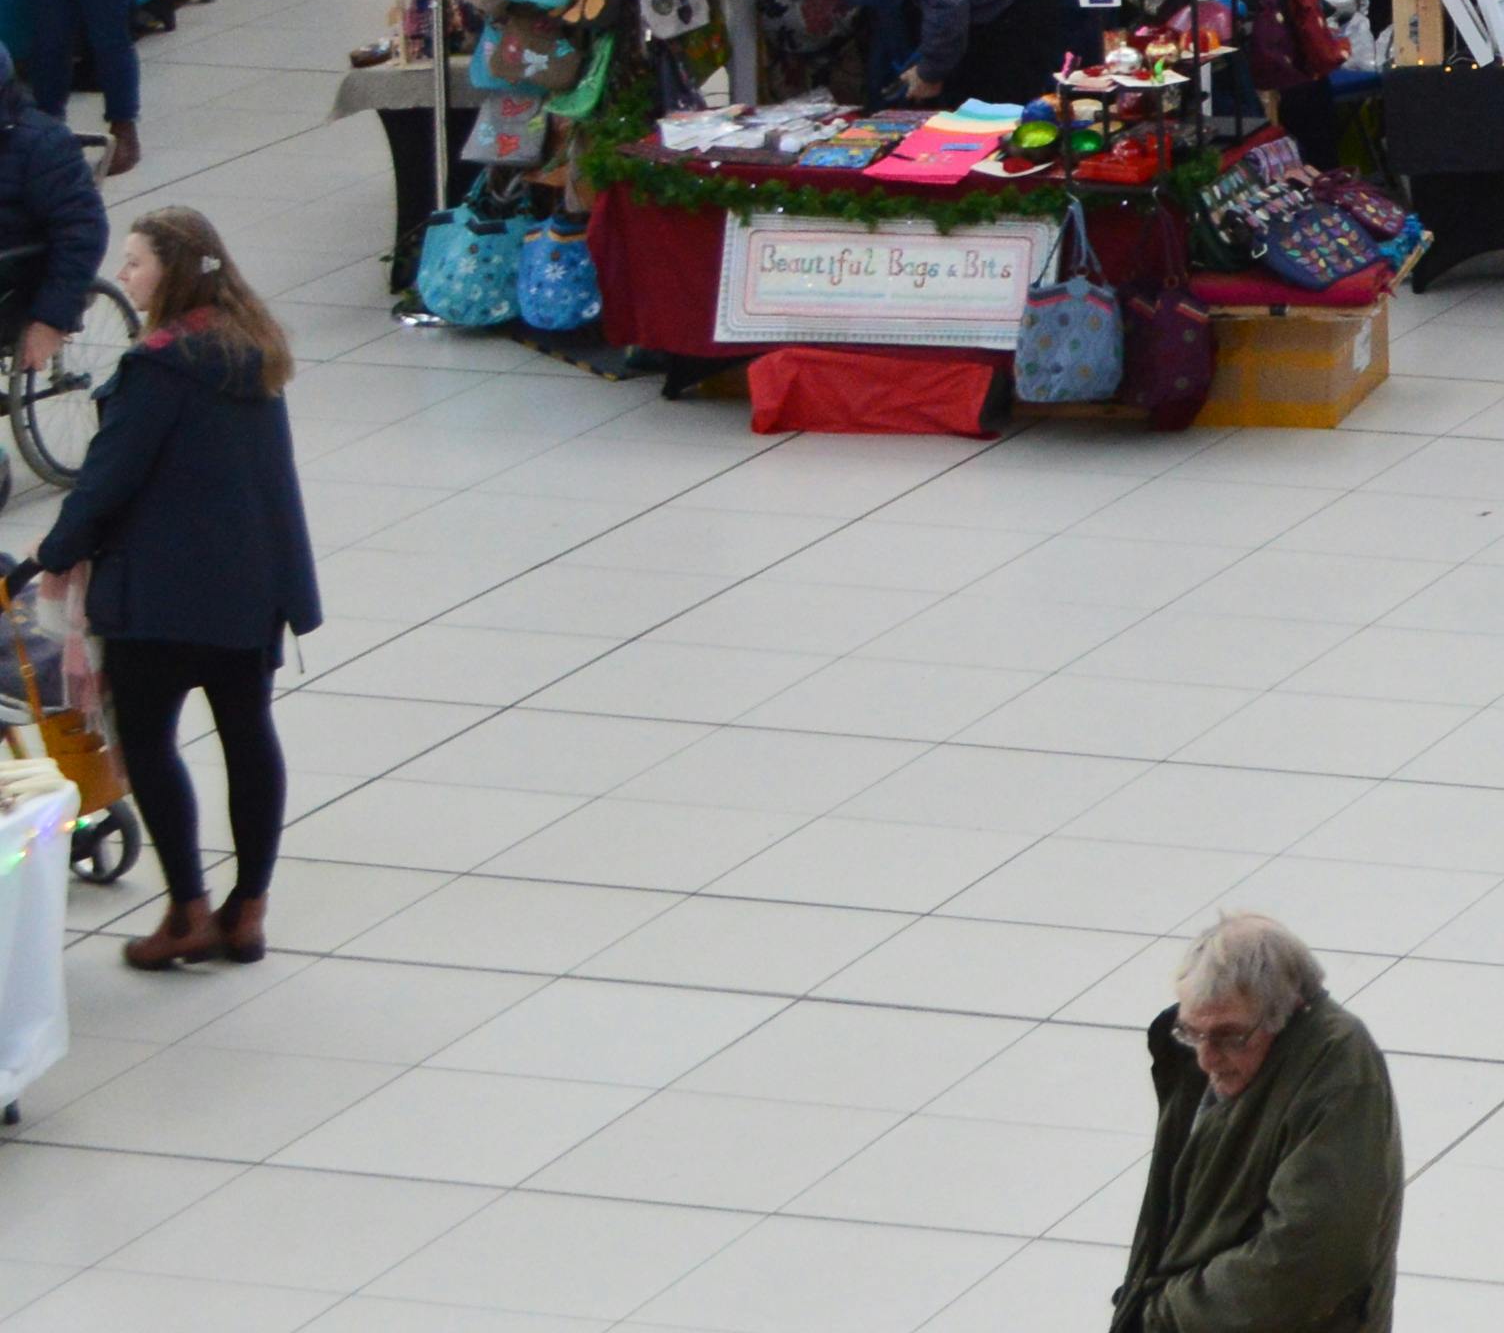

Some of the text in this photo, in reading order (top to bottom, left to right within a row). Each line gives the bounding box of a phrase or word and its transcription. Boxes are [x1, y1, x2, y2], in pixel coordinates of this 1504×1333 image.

[760, 244, 876, 286] Beautiful
[888, 248, 939, 288] Bags
[963, 250, 1012, 279] Bits
